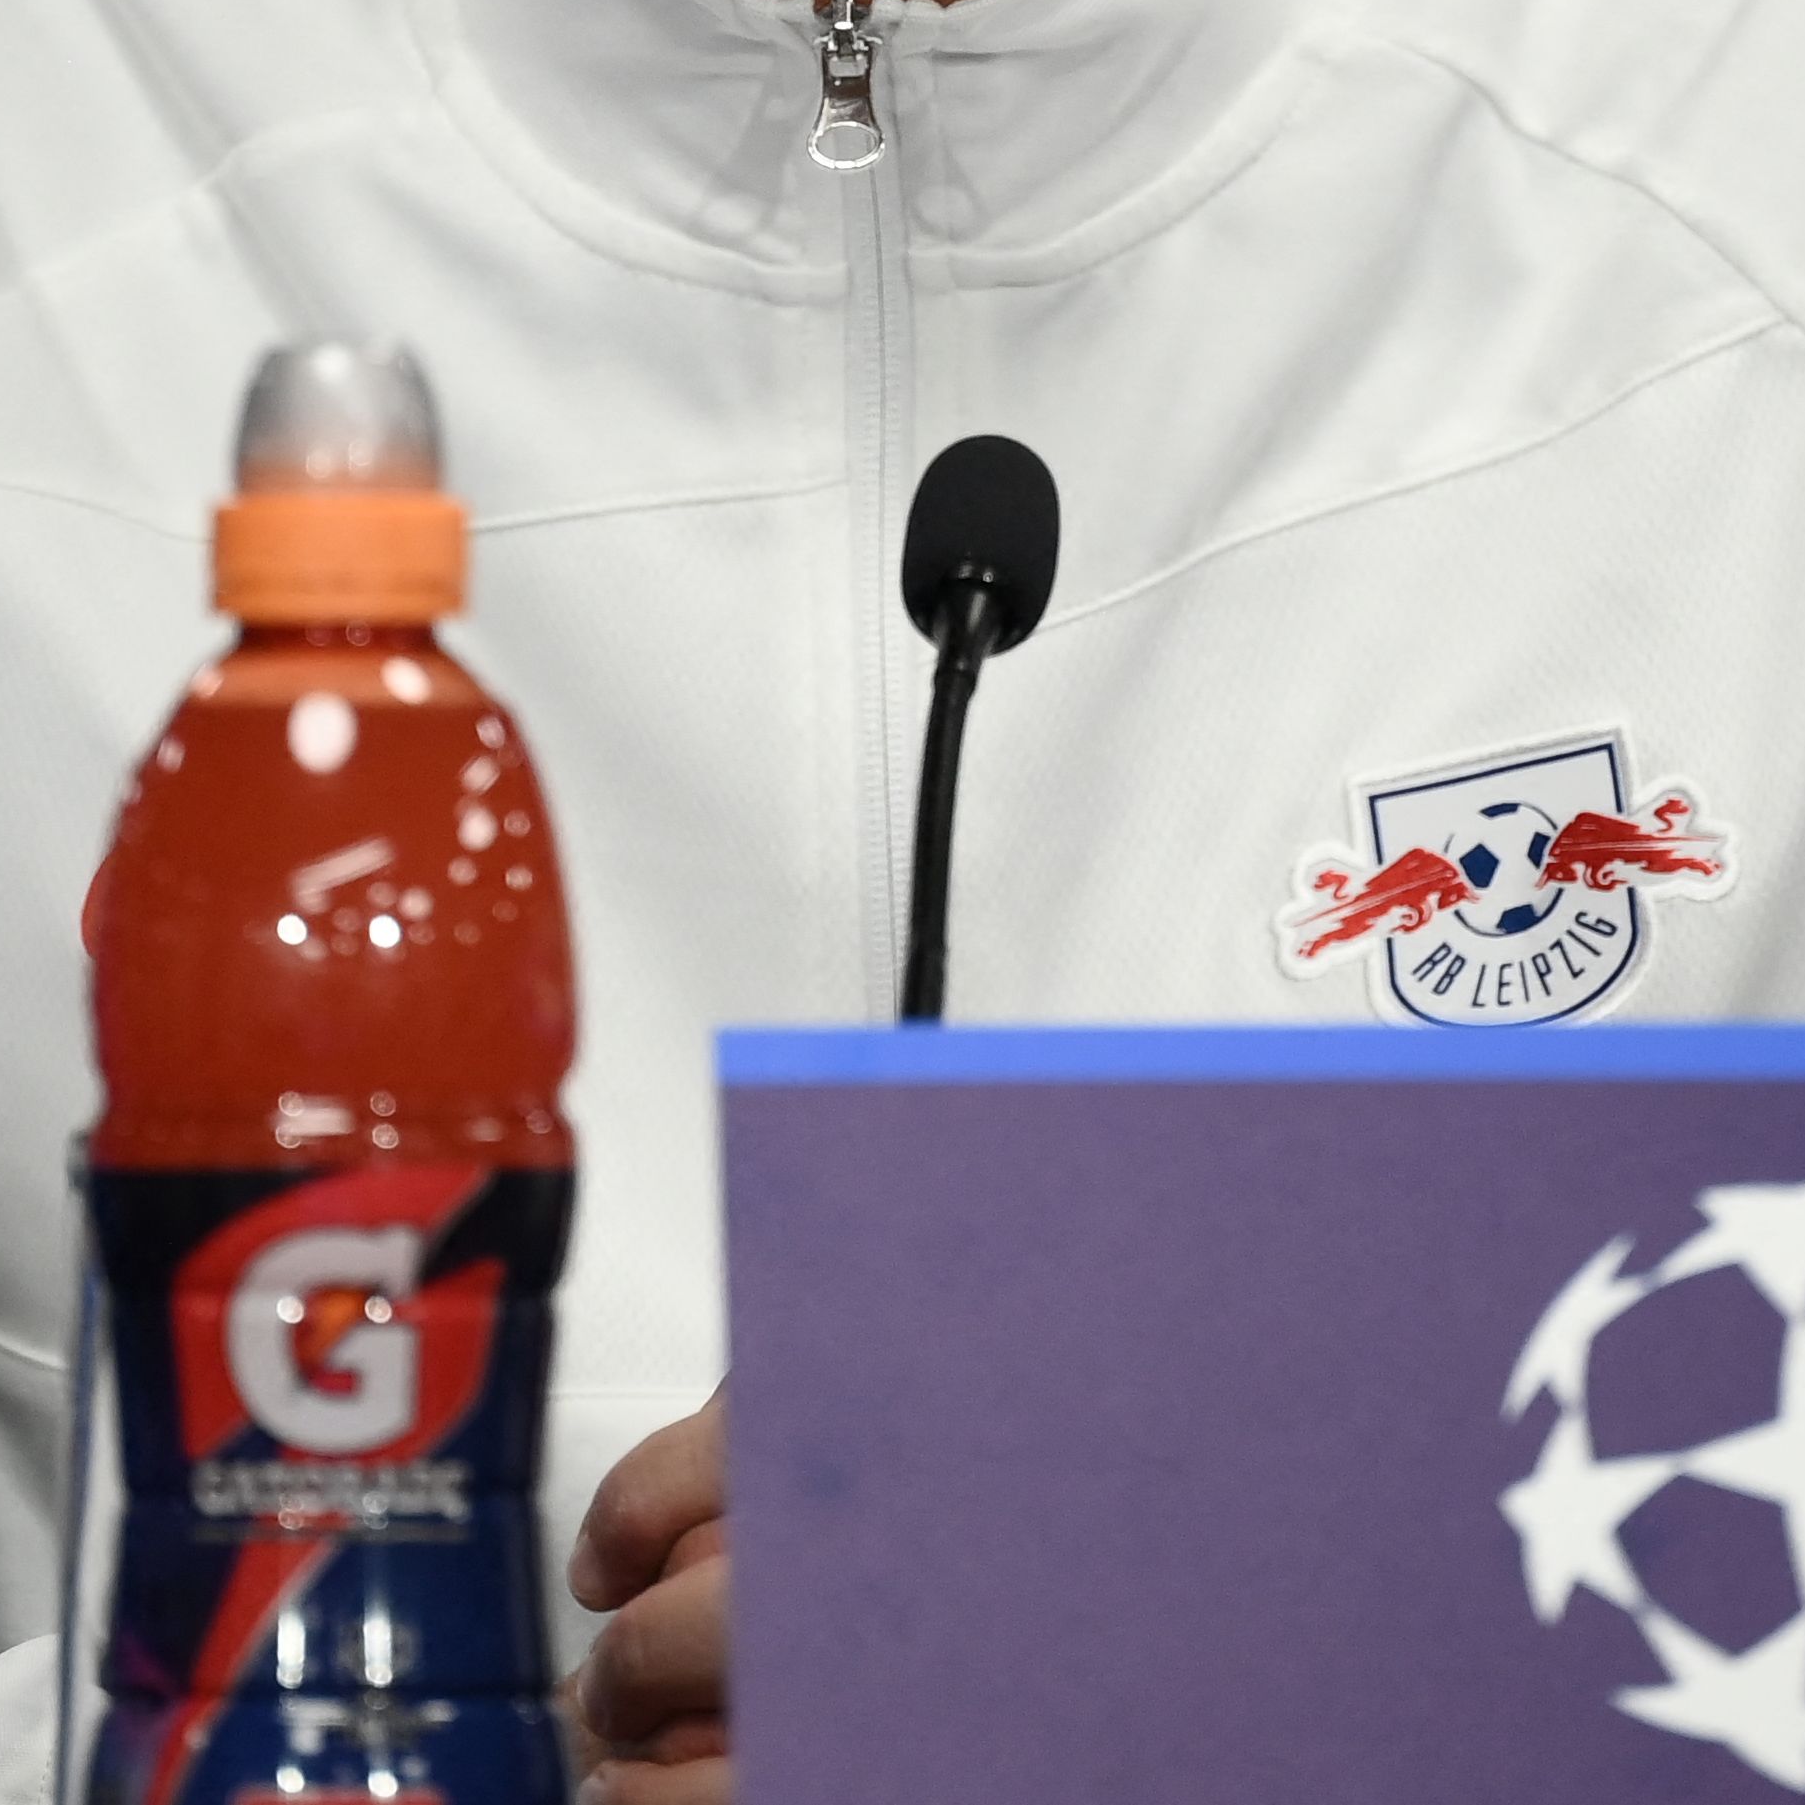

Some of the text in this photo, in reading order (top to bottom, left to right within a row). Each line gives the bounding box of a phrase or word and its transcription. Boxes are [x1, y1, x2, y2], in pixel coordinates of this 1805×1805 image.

[1413, 909, 1618, 1009] RB LEIPZIG
[226, 1226, 424, 1454] G
